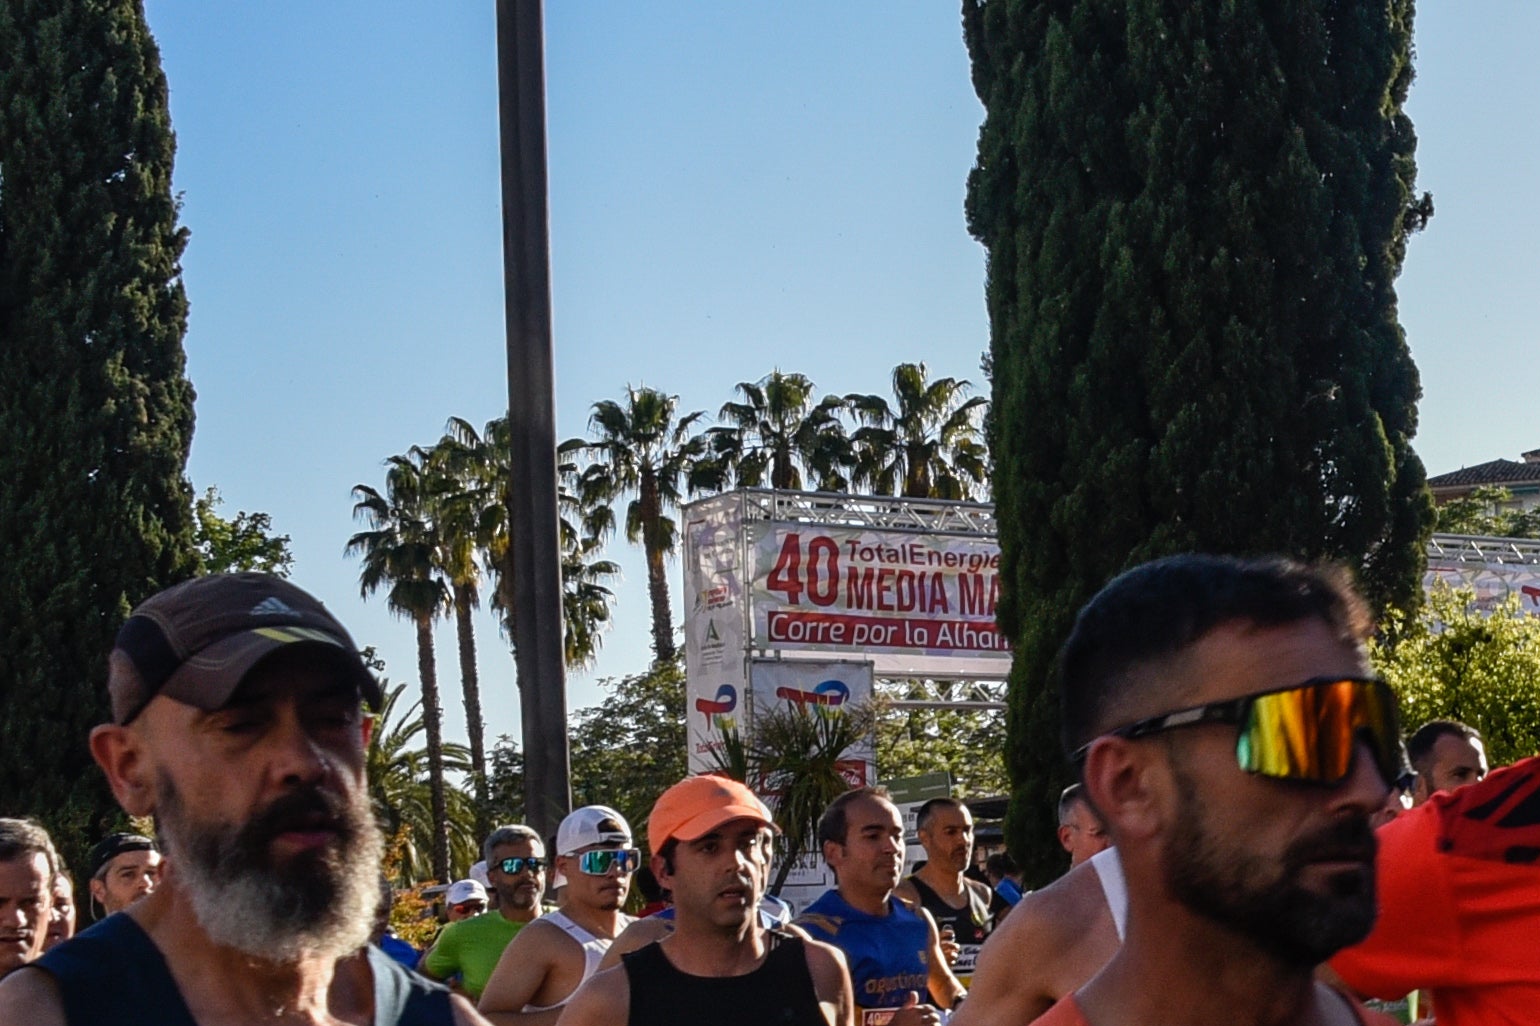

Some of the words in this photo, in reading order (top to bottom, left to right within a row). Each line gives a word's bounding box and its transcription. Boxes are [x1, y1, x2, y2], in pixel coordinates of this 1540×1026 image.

[766, 533, 840, 606] 40
[846, 540, 1000, 573] TotalEnergie
[846, 566, 948, 615] MEDIA
[958, 572, 1003, 616] MA
[771, 613, 844, 643] Corre
[852, 623, 898, 646] por
[905, 624, 928, 646] la
